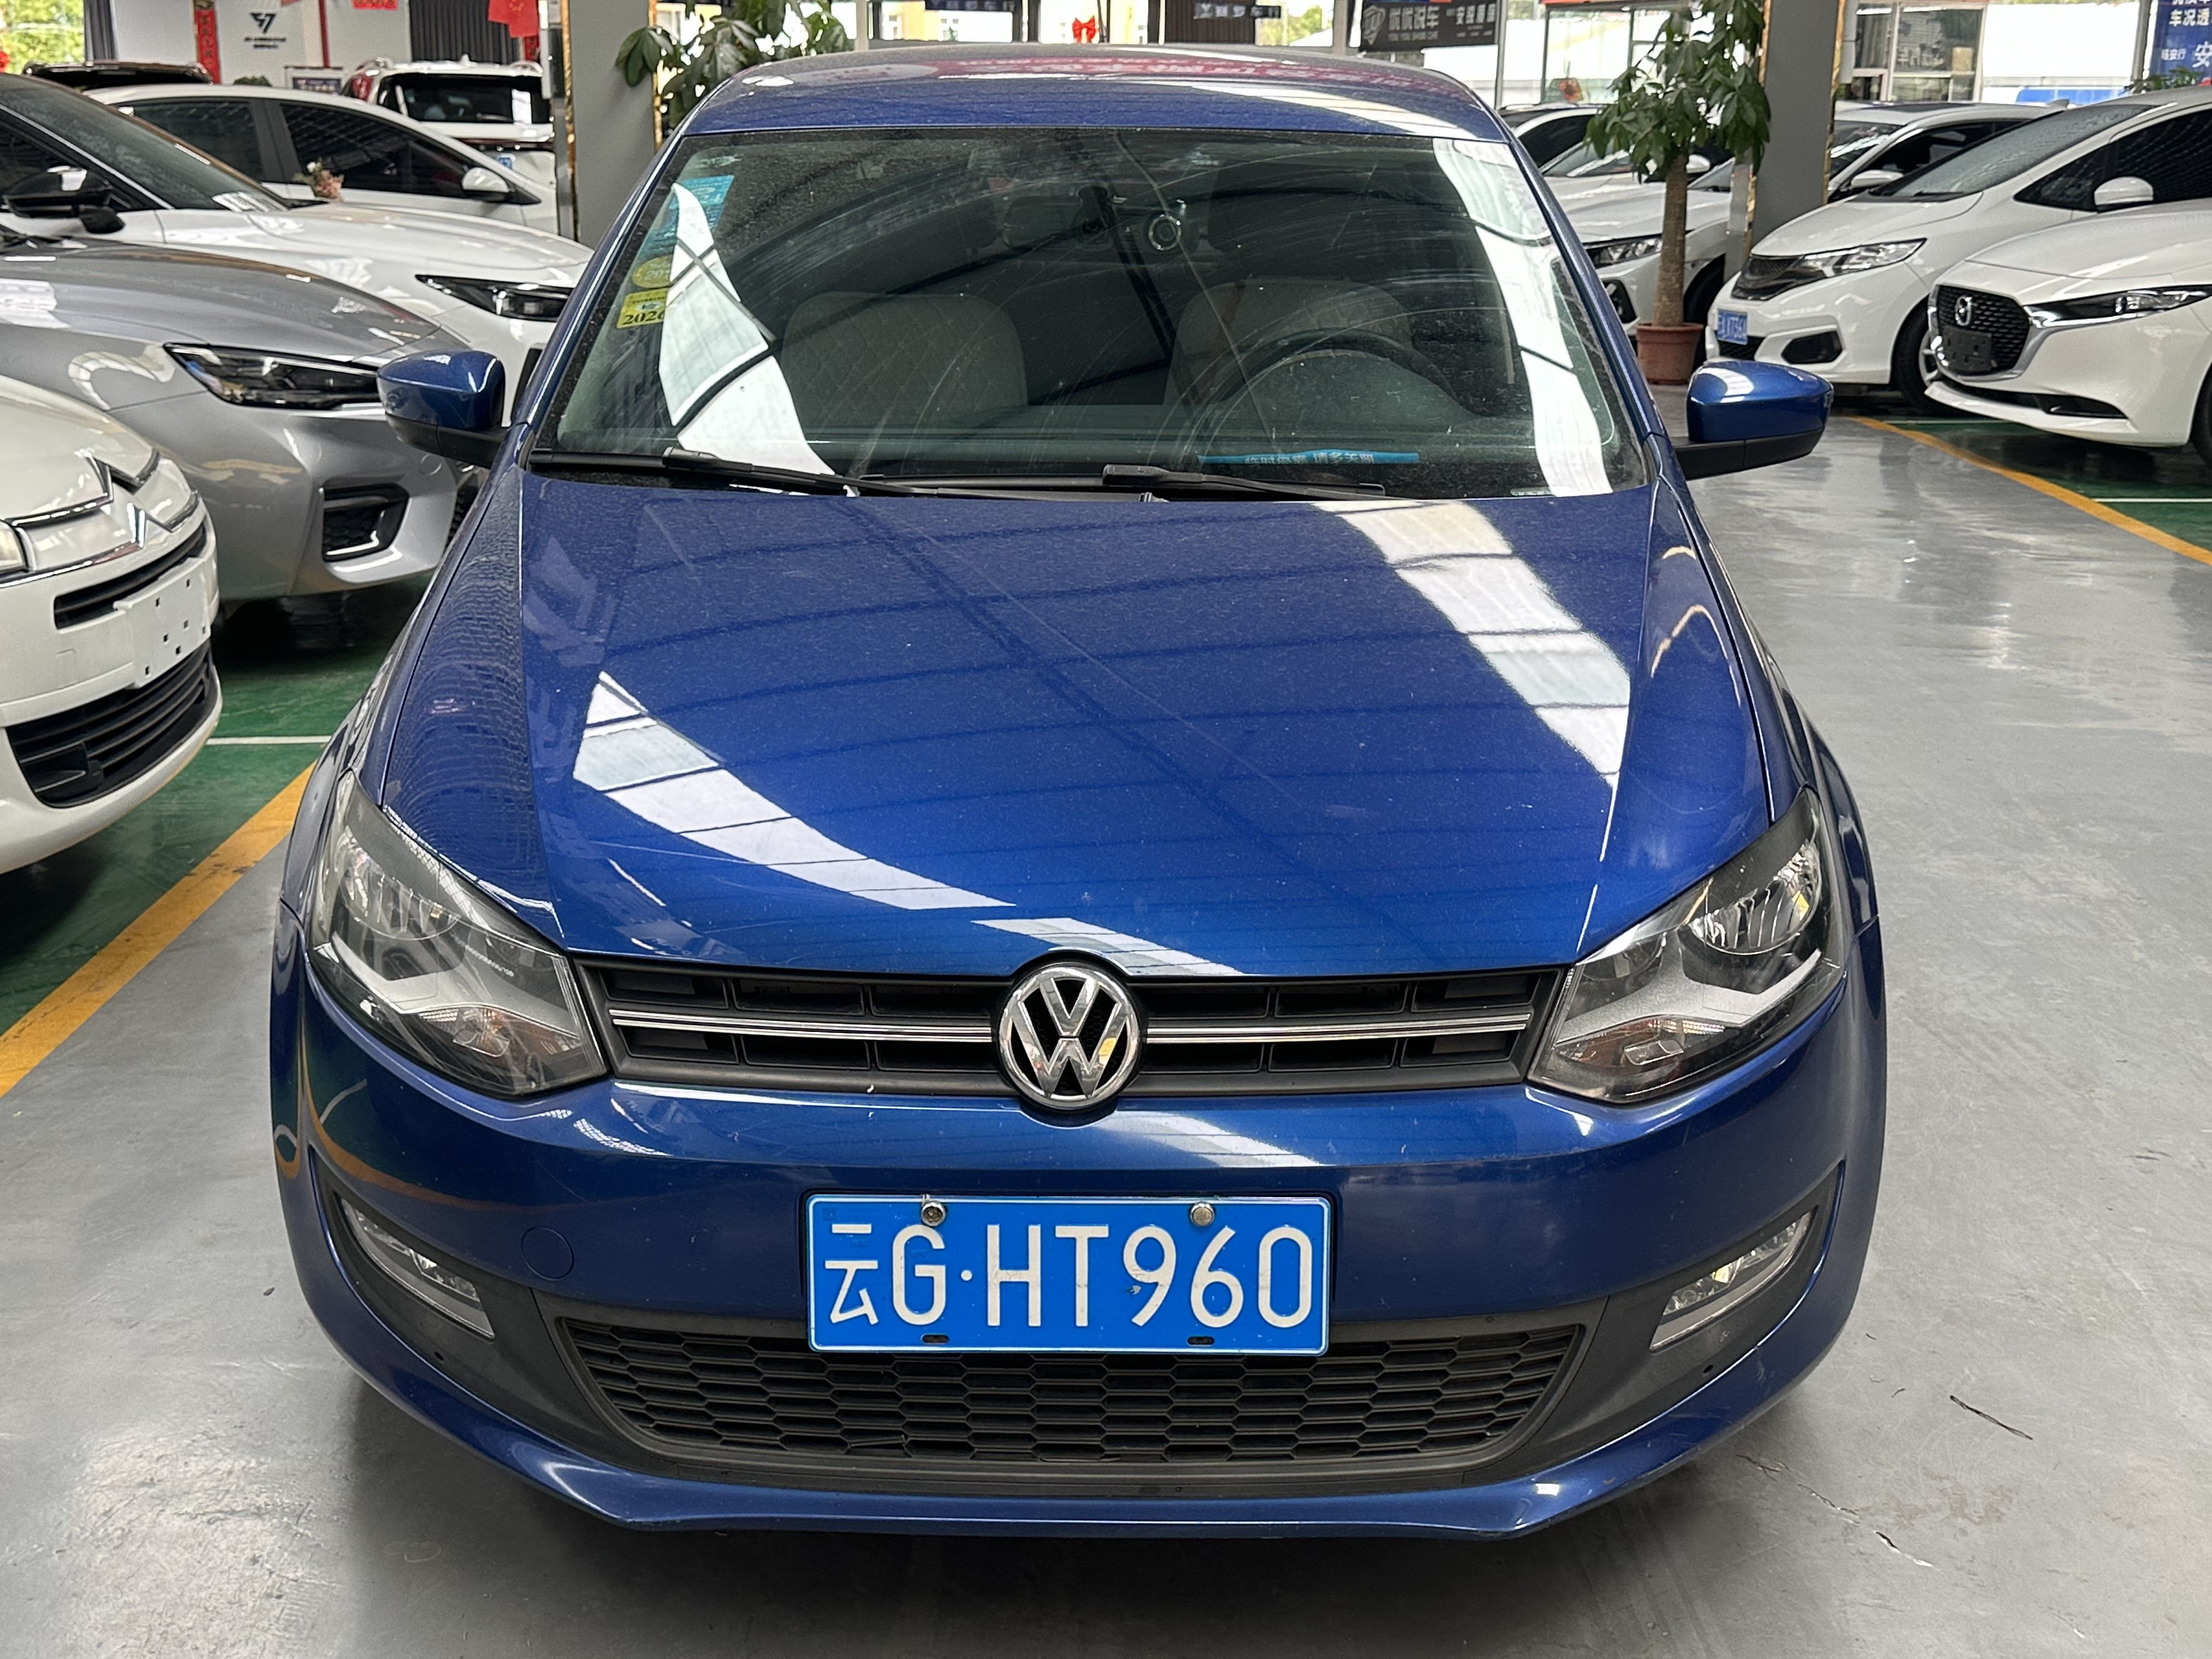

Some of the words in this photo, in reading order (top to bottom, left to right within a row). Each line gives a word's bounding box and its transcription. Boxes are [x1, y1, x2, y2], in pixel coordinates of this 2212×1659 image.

[2169, 8, 2212, 26] 车况透
[825, 1223, 1312, 1328] 云G·HT960
